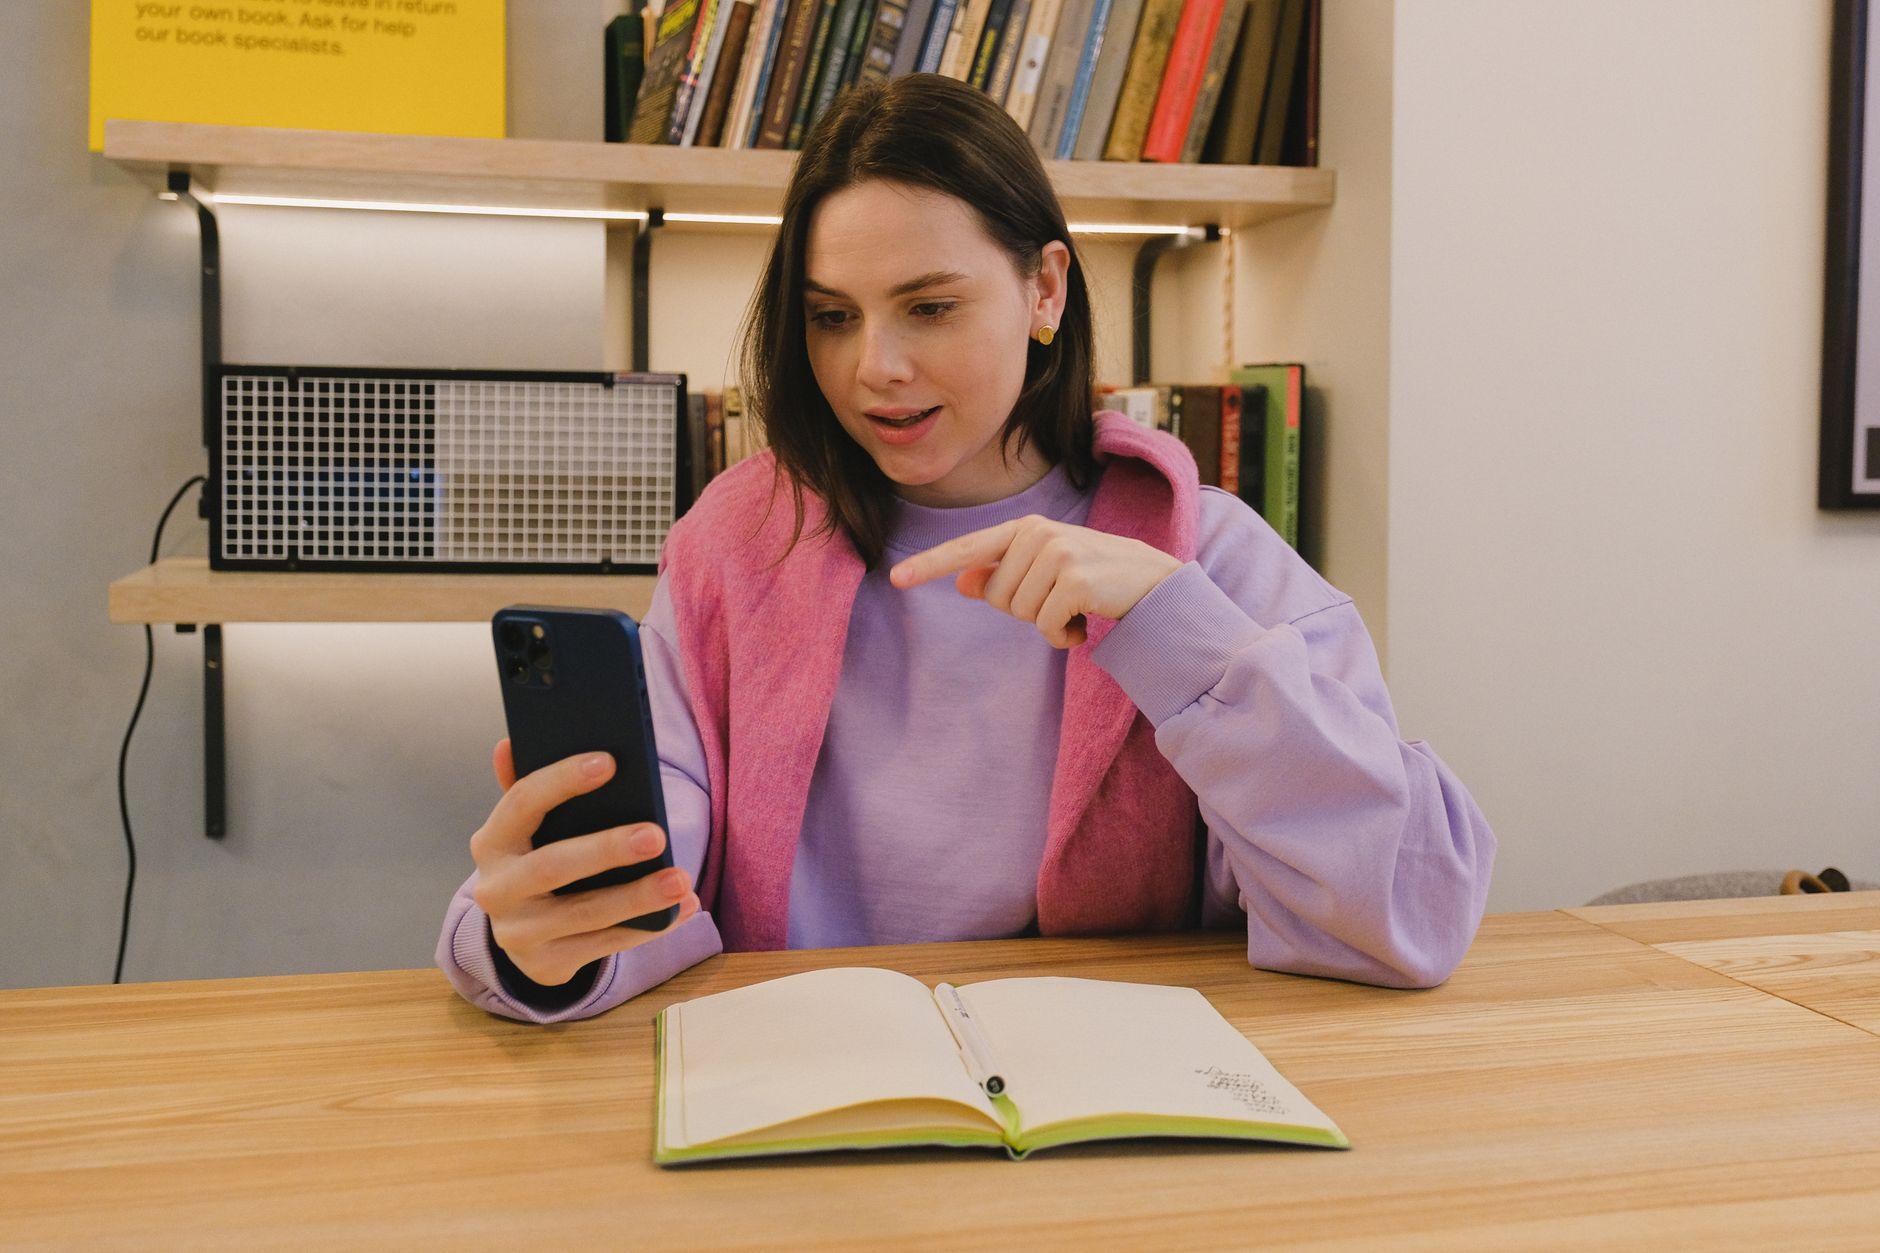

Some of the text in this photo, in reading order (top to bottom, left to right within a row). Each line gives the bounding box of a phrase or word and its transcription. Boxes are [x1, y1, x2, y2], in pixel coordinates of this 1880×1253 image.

[396, 0, 457, 15] return
[136, 3, 181, 19] your
[189, 6, 233, 21] own
[299, 11, 335, 30] Ask
[341, 14, 368, 32] for
[373, 18, 416, 37] help
[135, 26, 169, 42] our
[176, 28, 228, 46] book
